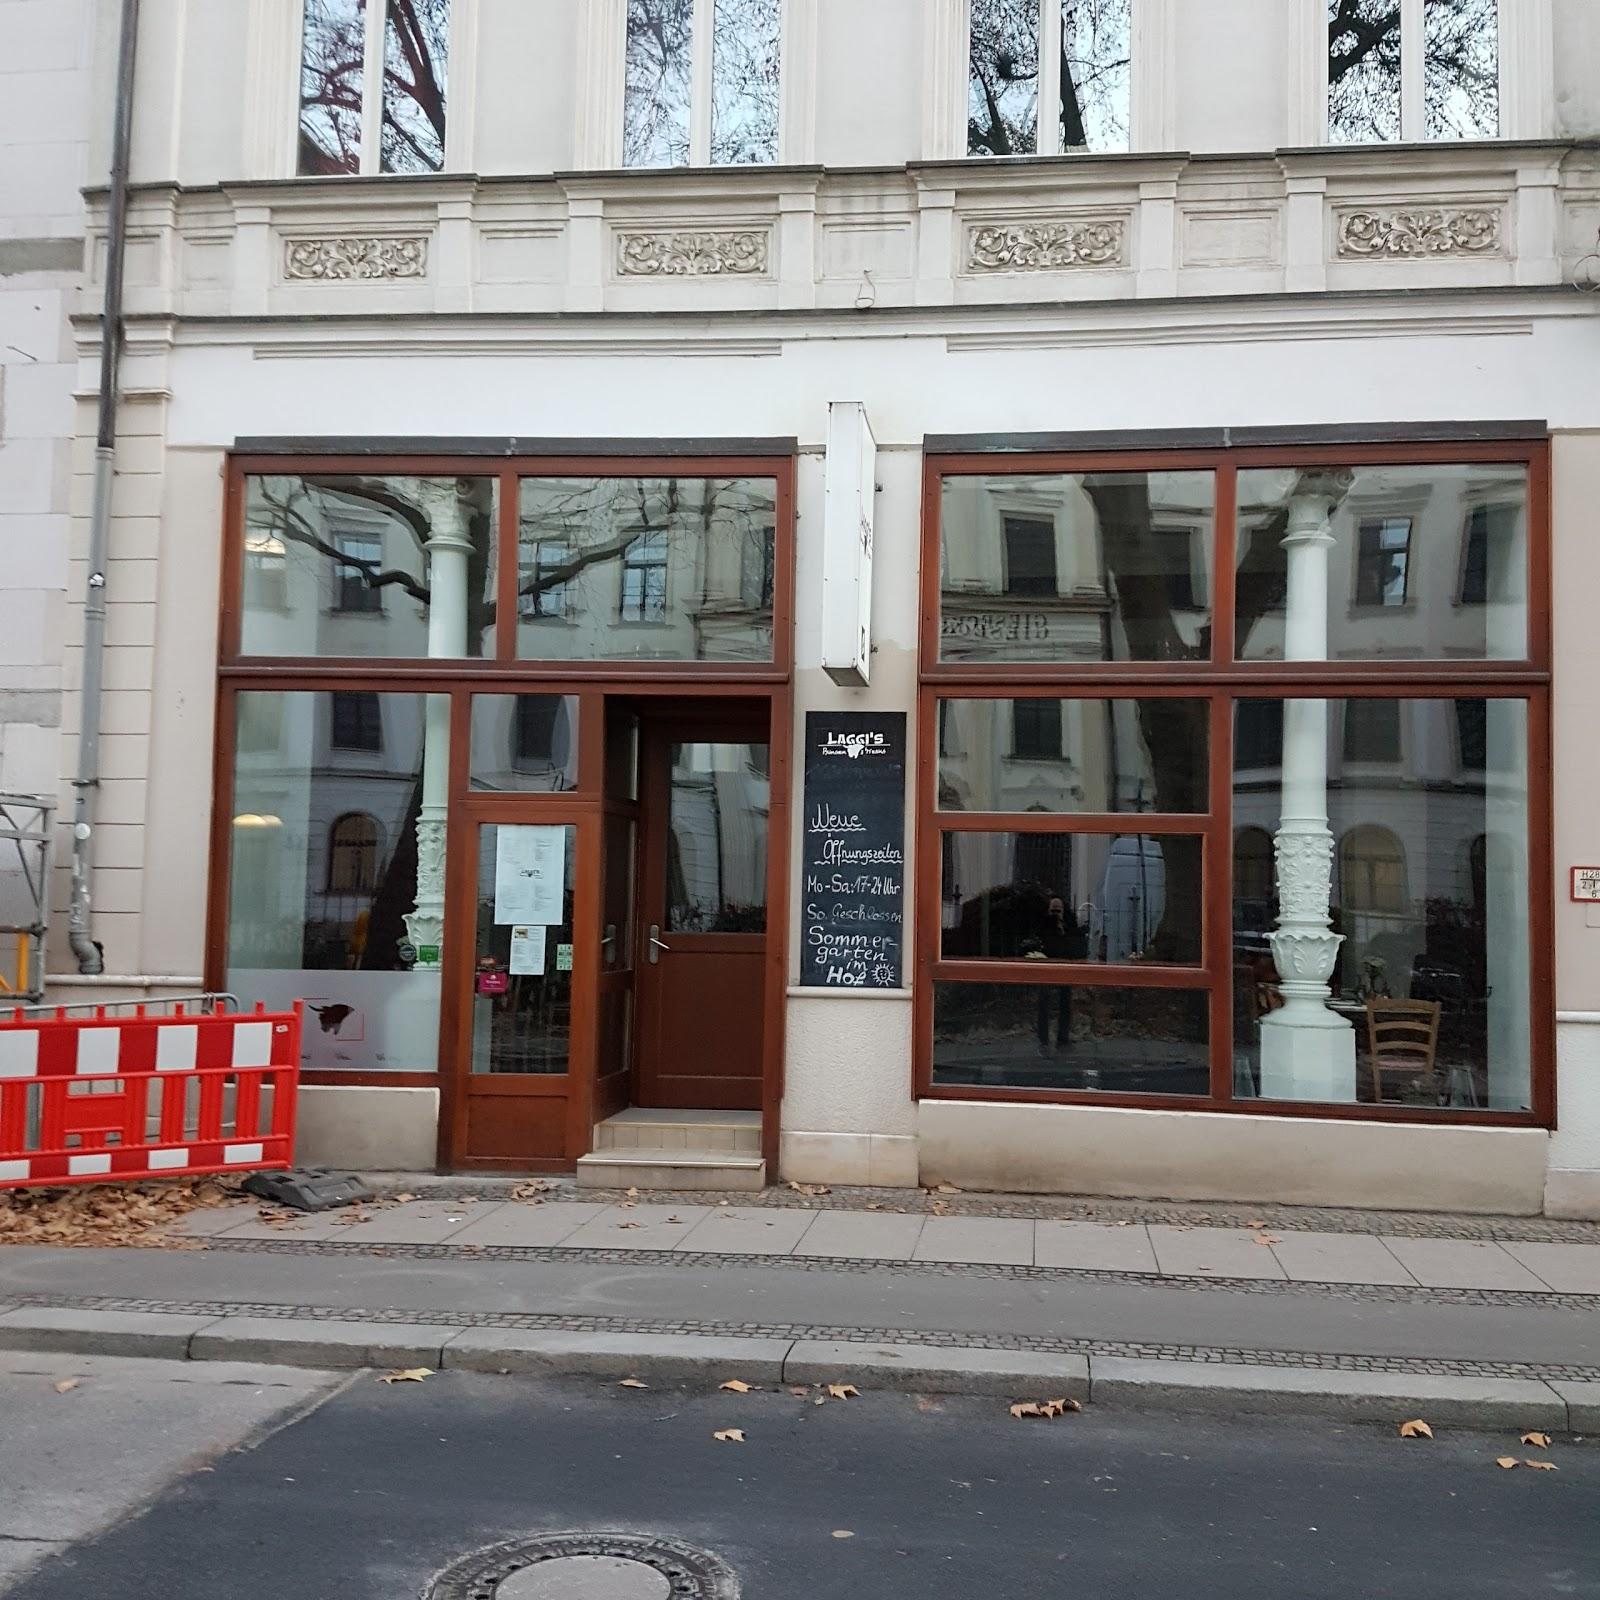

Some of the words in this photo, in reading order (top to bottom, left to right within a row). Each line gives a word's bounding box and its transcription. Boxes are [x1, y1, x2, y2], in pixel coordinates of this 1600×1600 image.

[827, 731, 884, 746] LAGGI'S
[812, 803, 862, 828] Neue
[883, 876, 901, 895] Uhr
[815, 946, 888, 964] garten
[846, 958, 868, 971] im
[826, 966, 867, 986] Hof
